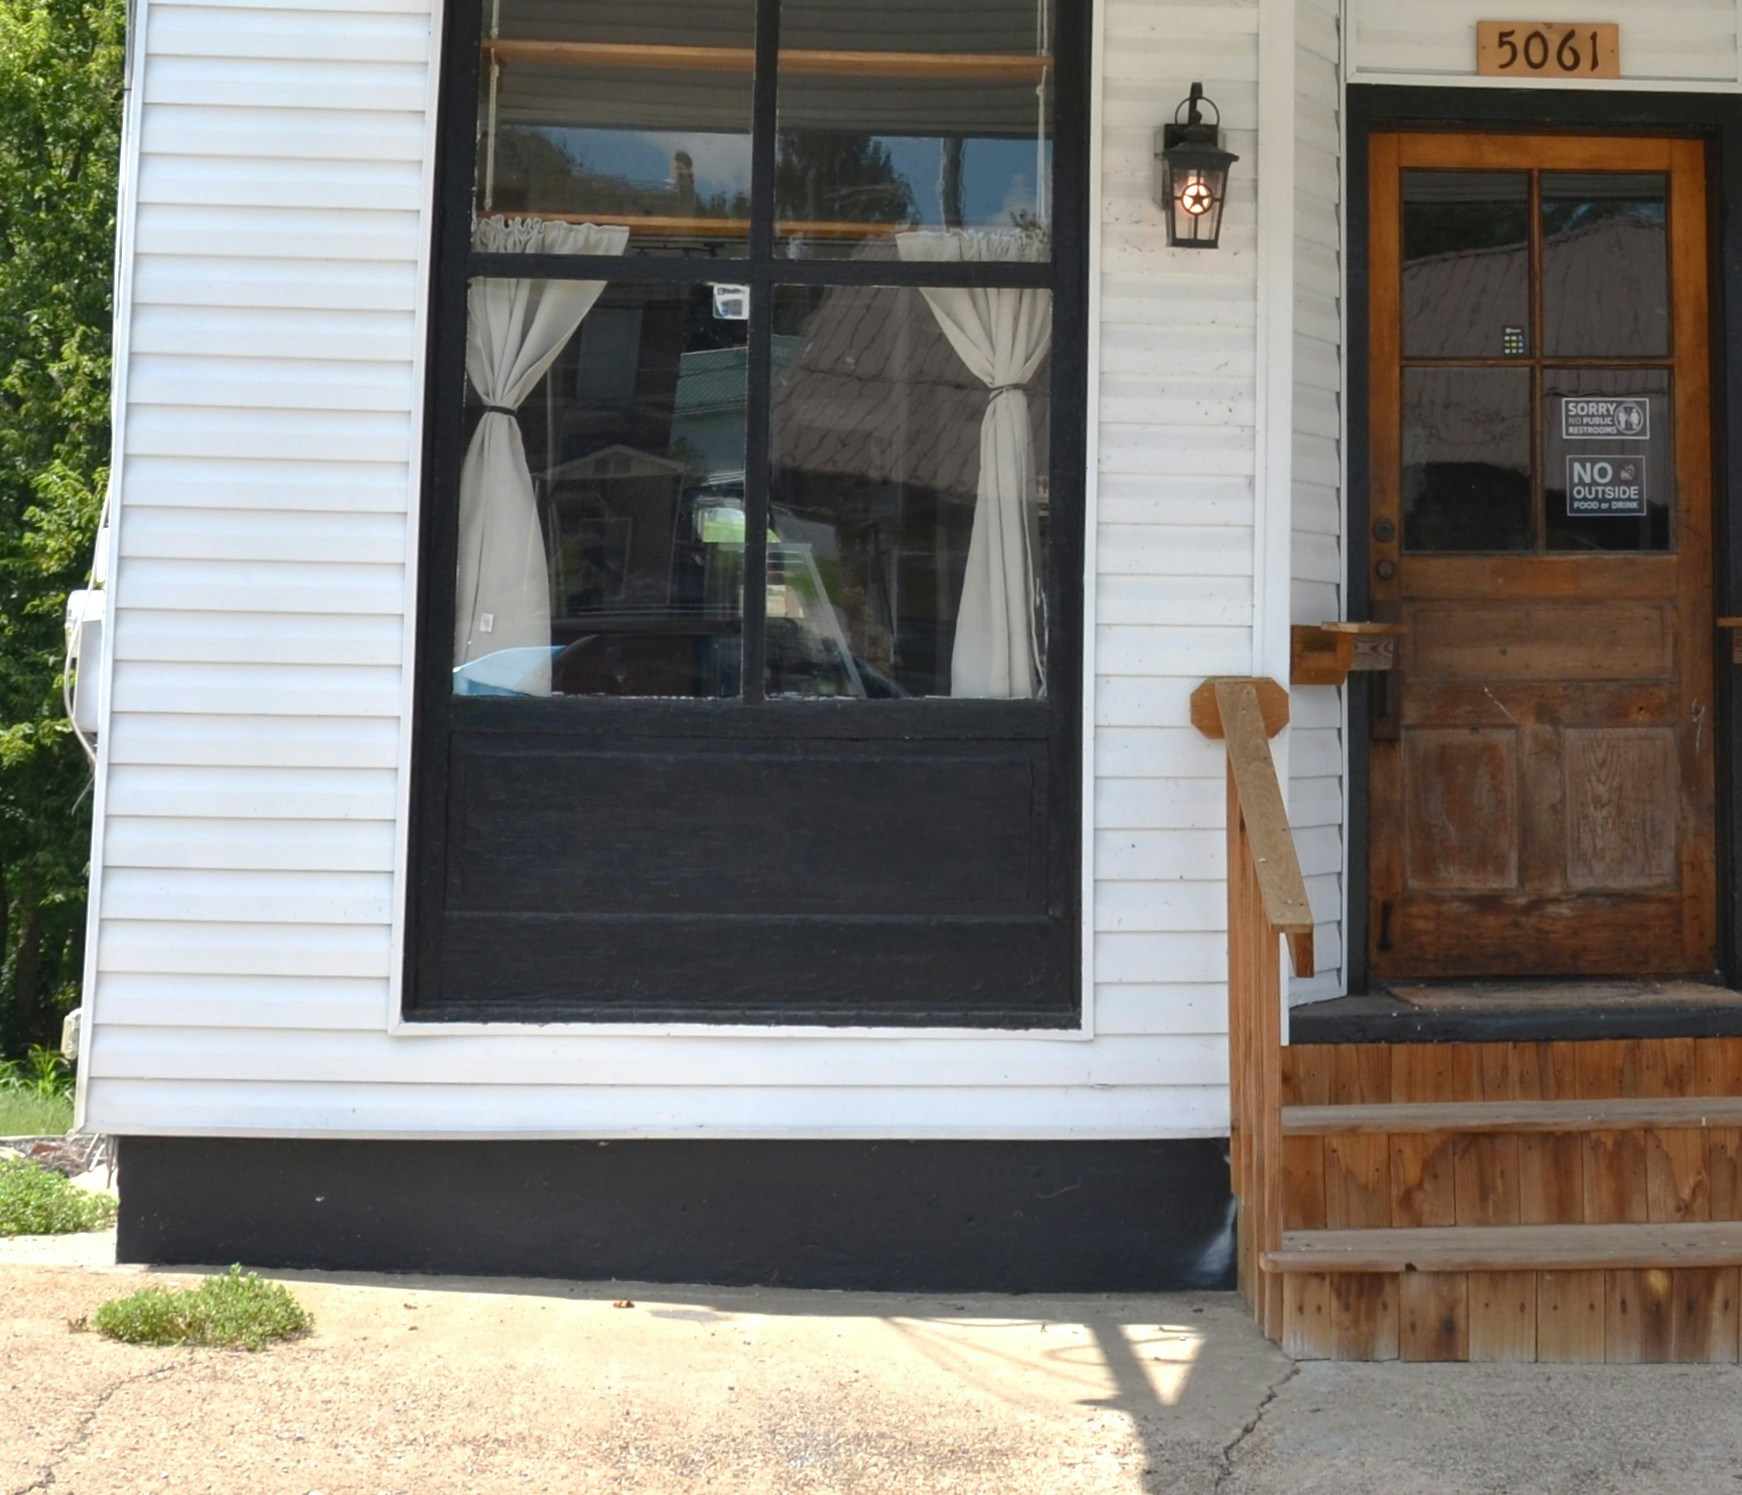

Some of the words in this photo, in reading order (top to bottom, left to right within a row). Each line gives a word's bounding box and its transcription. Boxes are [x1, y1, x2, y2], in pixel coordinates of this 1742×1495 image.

[1498, 29, 1599, 71] 5061
[1568, 403, 1616, 415] SORRY
[1568, 417, 1581, 425] NO
[1583, 417, 1613, 425] PUBLIC
[1568, 426, 1617, 434] RESTROOMS
[1573, 462, 1613, 484] NO
[1573, 486, 1640, 499] OUTSIDE
[1574, 501, 1599, 510] FOOD
[1600, 502, 1610, 510] or
[1611, 501, 1640, 510] DRINK
